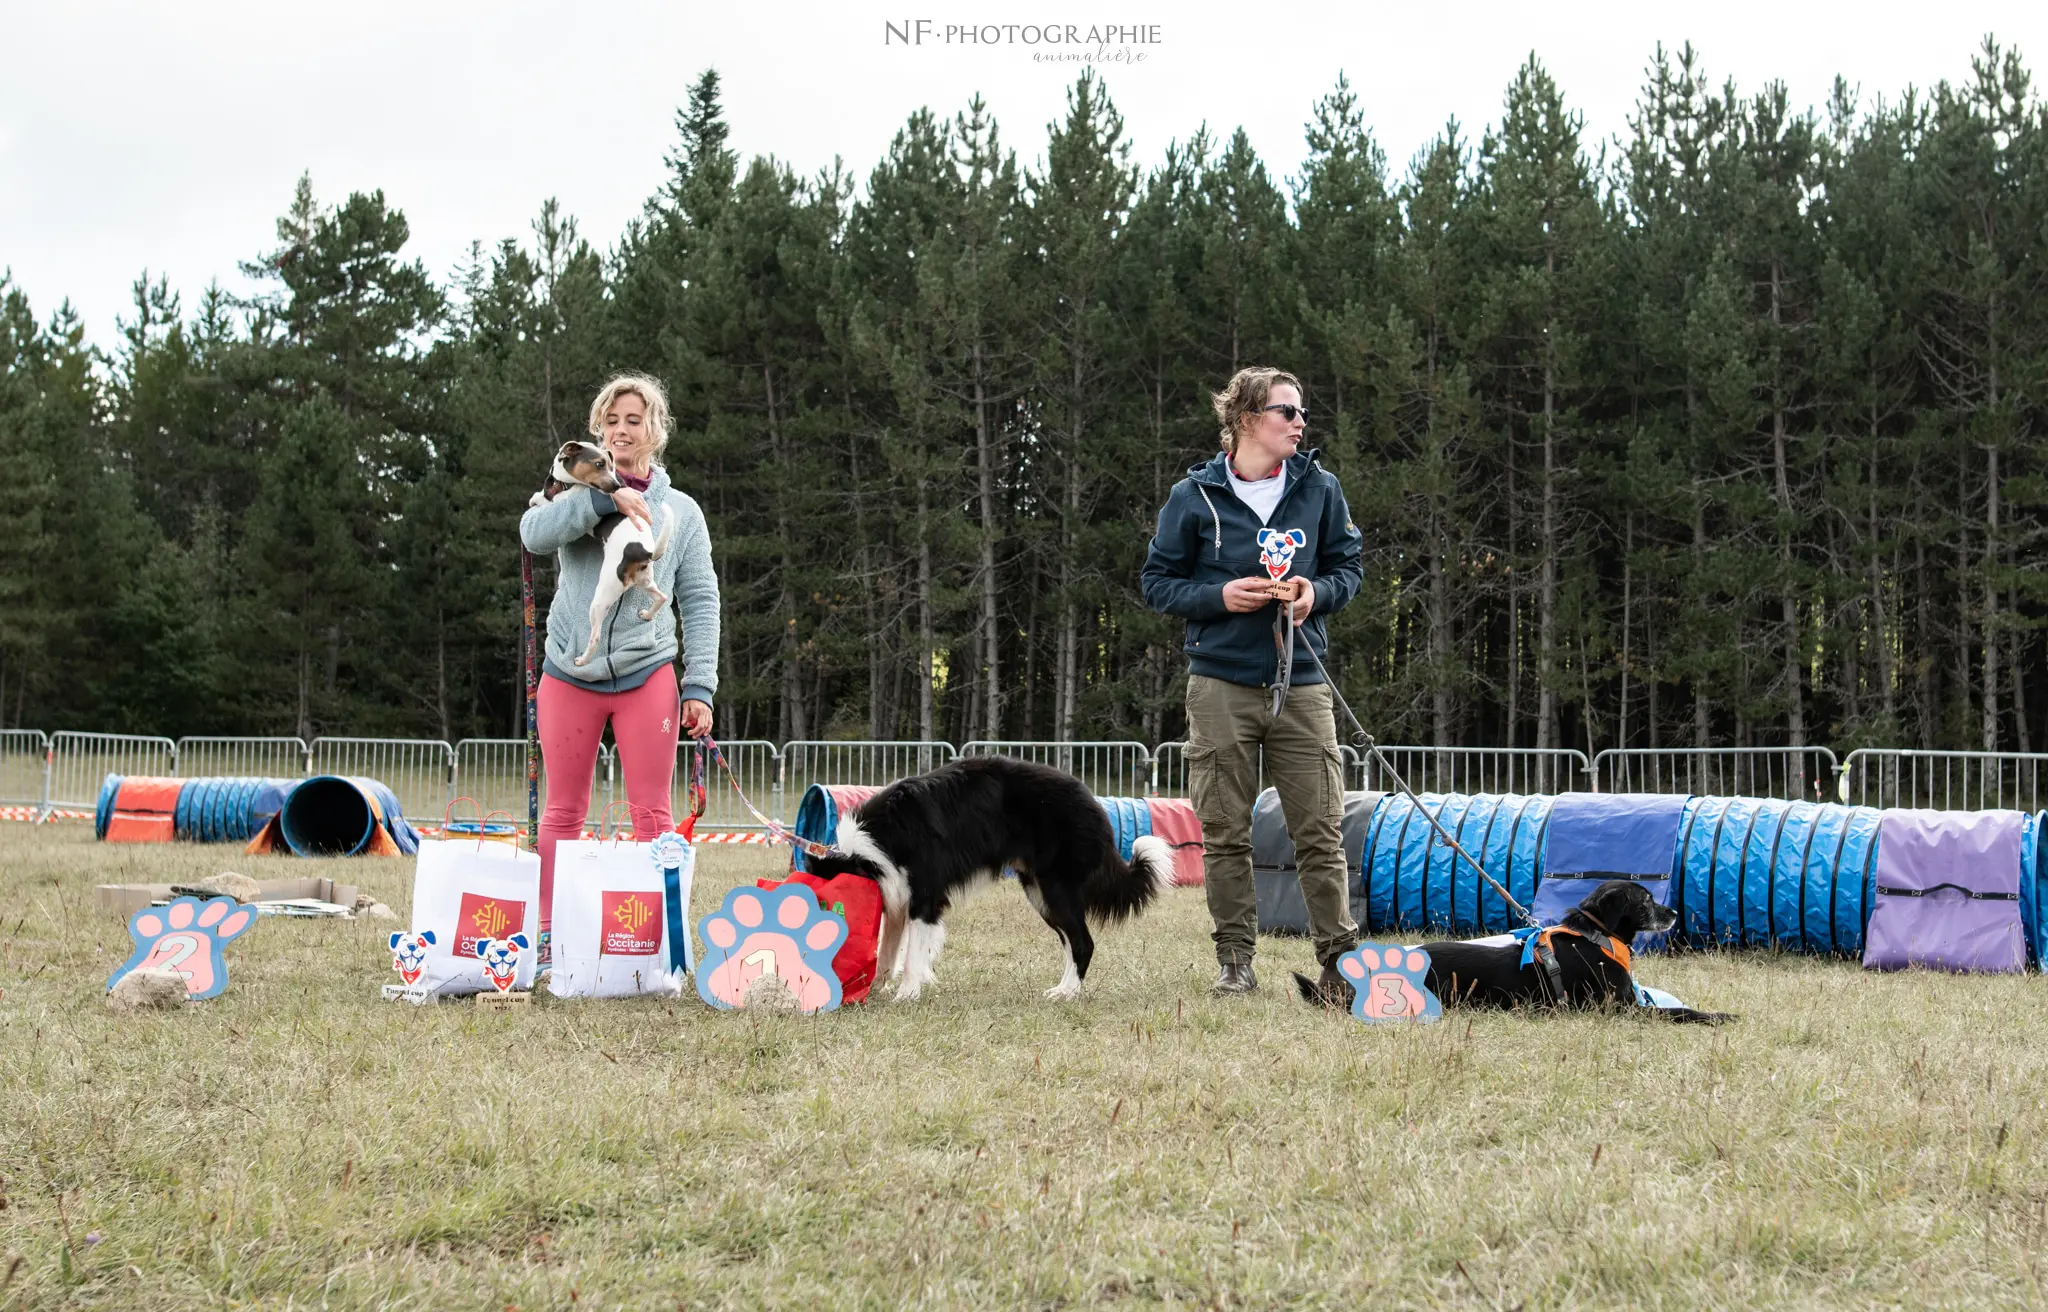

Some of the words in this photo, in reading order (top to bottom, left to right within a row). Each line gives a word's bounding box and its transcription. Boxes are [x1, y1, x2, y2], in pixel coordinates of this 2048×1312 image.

[159, 934, 199, 981] 2
[608, 938, 656, 948] Occitanie
[1377, 978, 1408, 1016] 3
